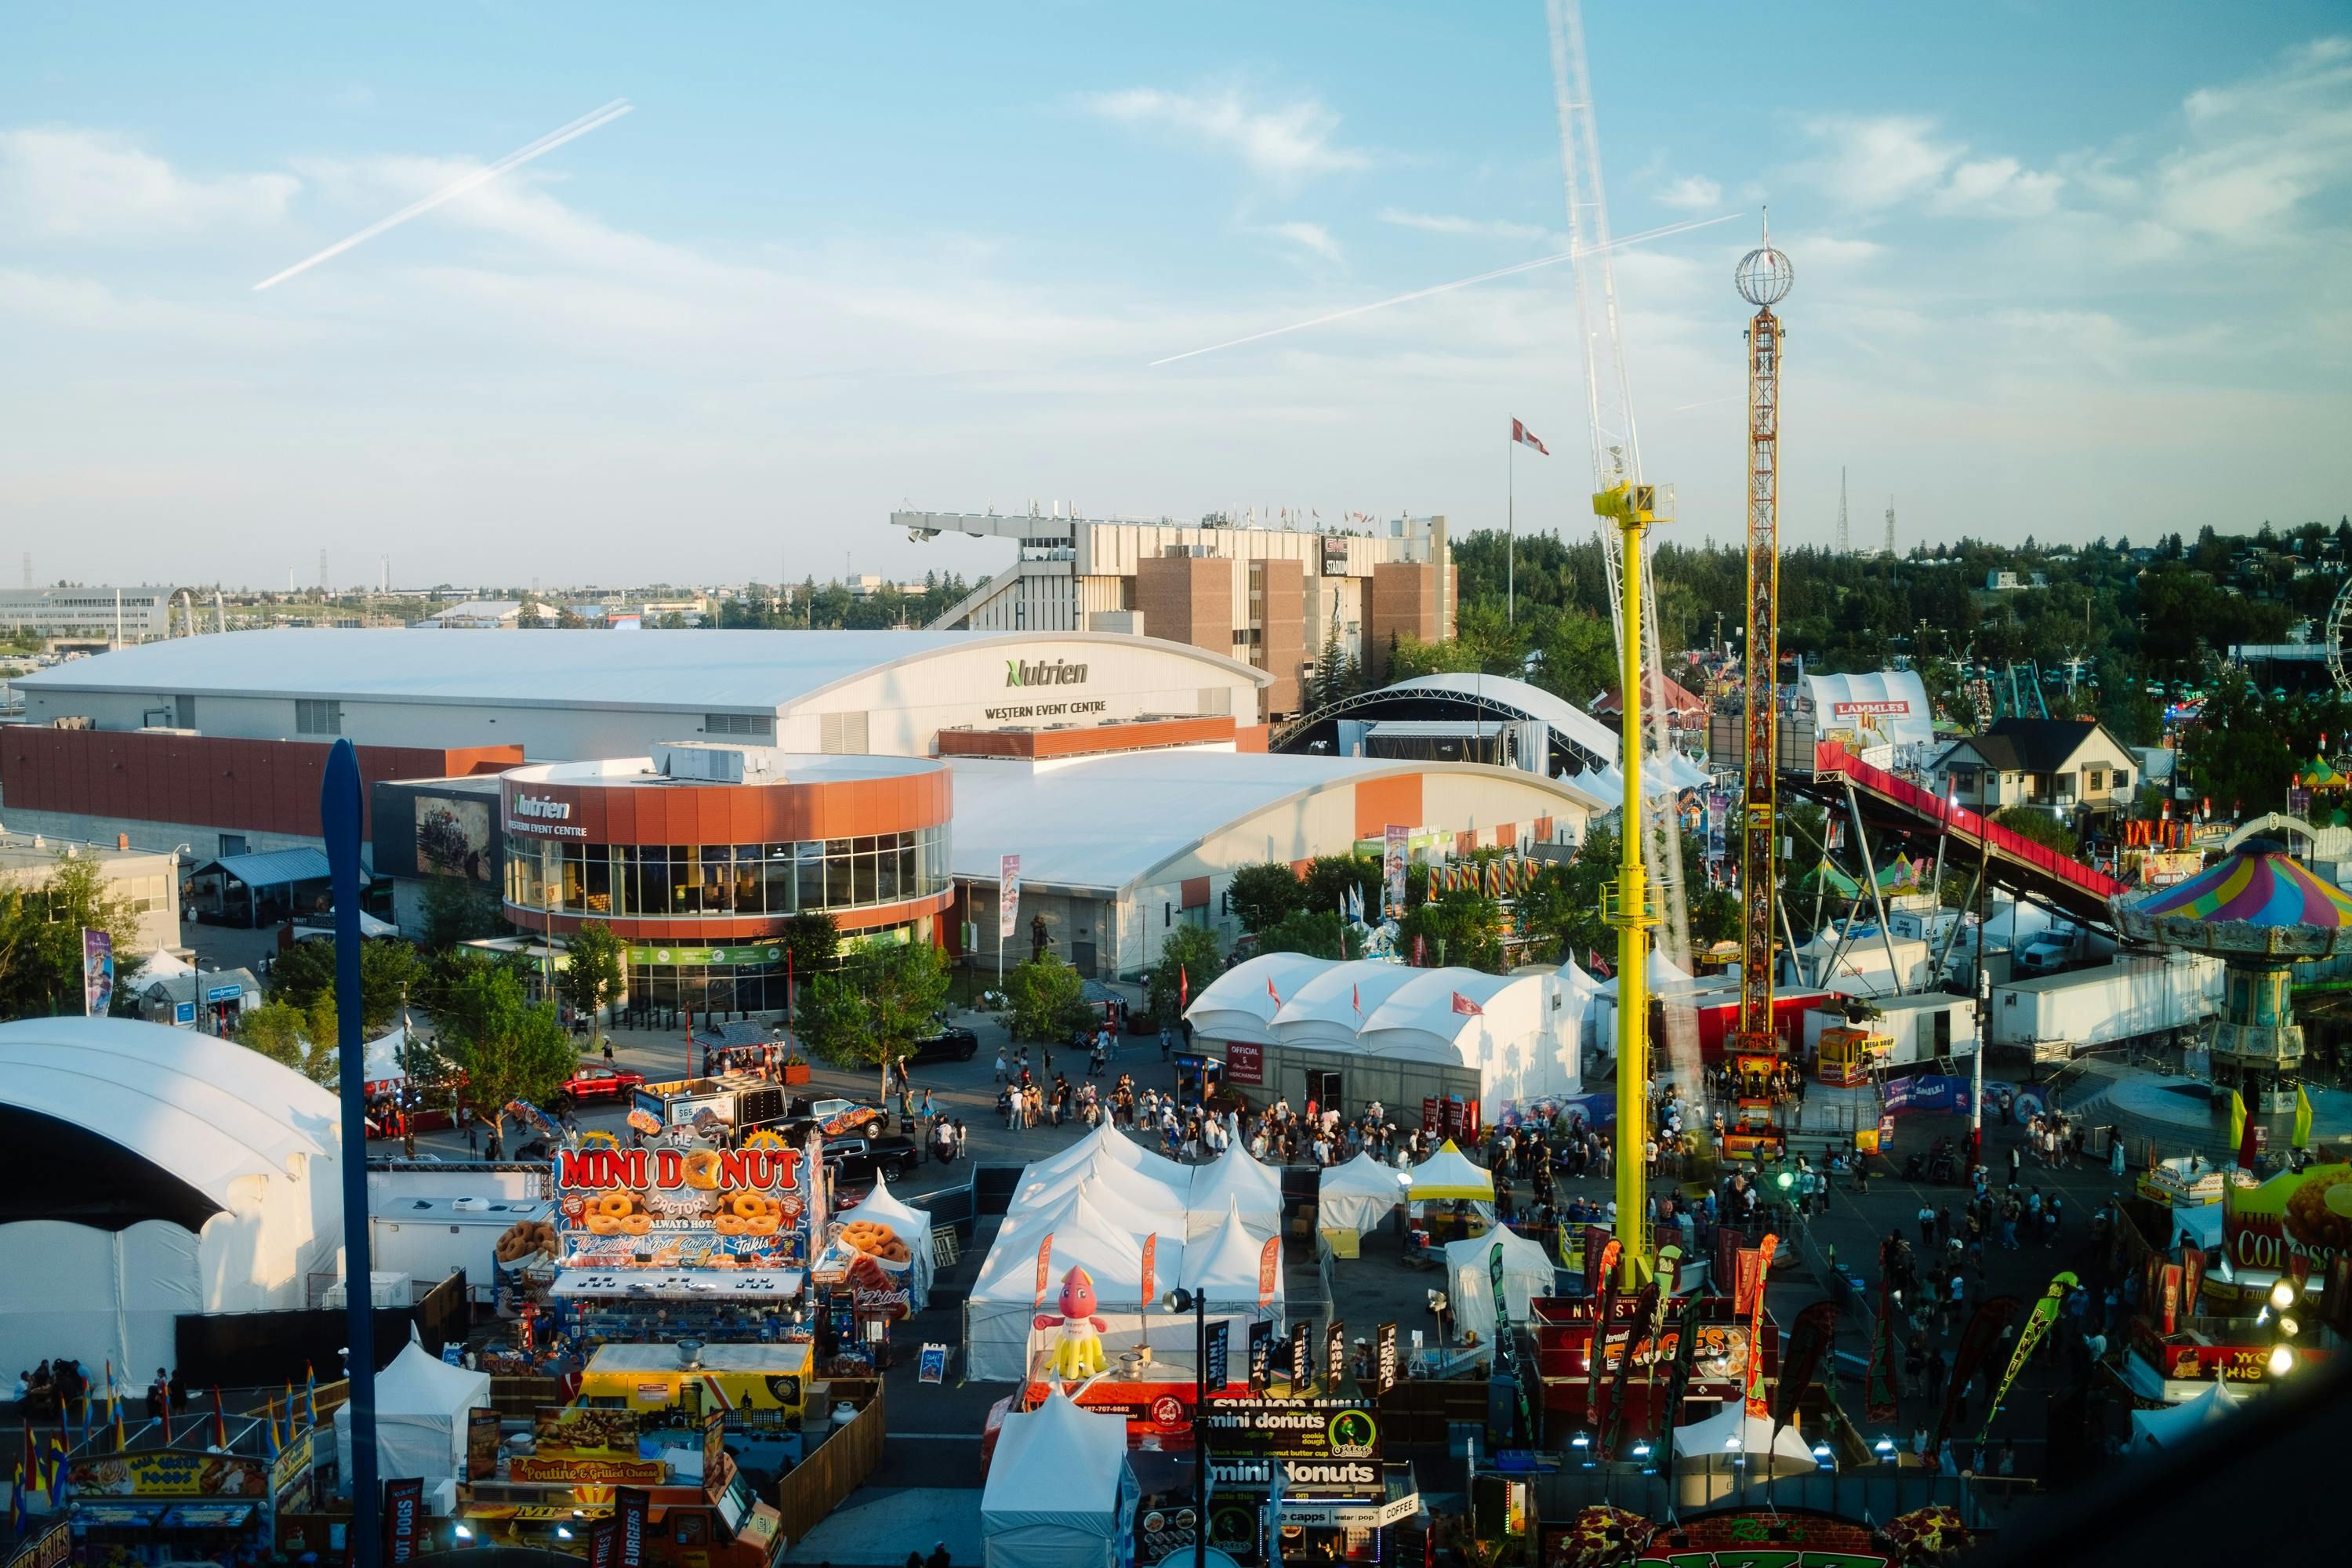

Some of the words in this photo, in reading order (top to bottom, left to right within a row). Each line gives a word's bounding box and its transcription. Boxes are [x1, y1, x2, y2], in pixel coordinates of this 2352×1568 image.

[1007, 659, 1088, 687] Nutrien
[985, 706, 1033, 719] WESTERN
[1036, 703, 1067, 716] EVENT
[1070, 700, 1106, 713] CENTRE
[514, 793, 570, 819] Nutrien
[508, 820, 529, 831] WESTERN
[531, 824, 553, 833] EVENT
[554, 826, 587, 837] CENTRE
[1231, 1046, 1259, 1055] OFFICIAL
[1864, 1040, 1879, 1050] MEGA
[1229, 1071, 1261, 1080] MERCHANDISE
[1916, 1083, 1944, 1096] SMILE!
[666, 1134, 693, 1148] THE
[559, 1148, 650, 1190] MINI
[651, 1193, 710, 1214] FACTORY
[648, 1219, 689, 1230] ALWAYS
[735, 1236, 769, 1255] Takis
[1210, 1341, 1218, 1380] MINI
[1217, 1325, 1227, 1388] DONUTS
[1253, 1339, 1263, 1377] ICED
[1294, 1340, 1304, 1380] MINI
[1380, 1341, 1389, 1381] MINI
[1385, 1327, 1396, 1388] DONUTS
[1208, 1411, 1250, 1428] mini
[1254, 1412, 1326, 1428] donuts
[158, 1455, 201, 1469] GREEK
[1212, 1460, 1270, 1482] mini
[142, 1471, 191, 1484] FOODS
[526, 1466, 578, 1480] Poutine
[579, 1468, 588, 1479] &
[590, 1468, 624, 1479] Grilled
[626, 1468, 659, 1479] Cheese
[396, 1498, 414, 1536] DOGS
[1290, 1512, 1326, 1522] capps
[1387, 1500, 1414, 1519] COFFEE
[624, 1507, 641, 1566] BURGERS
[394, 1539, 411, 1565] HOT
